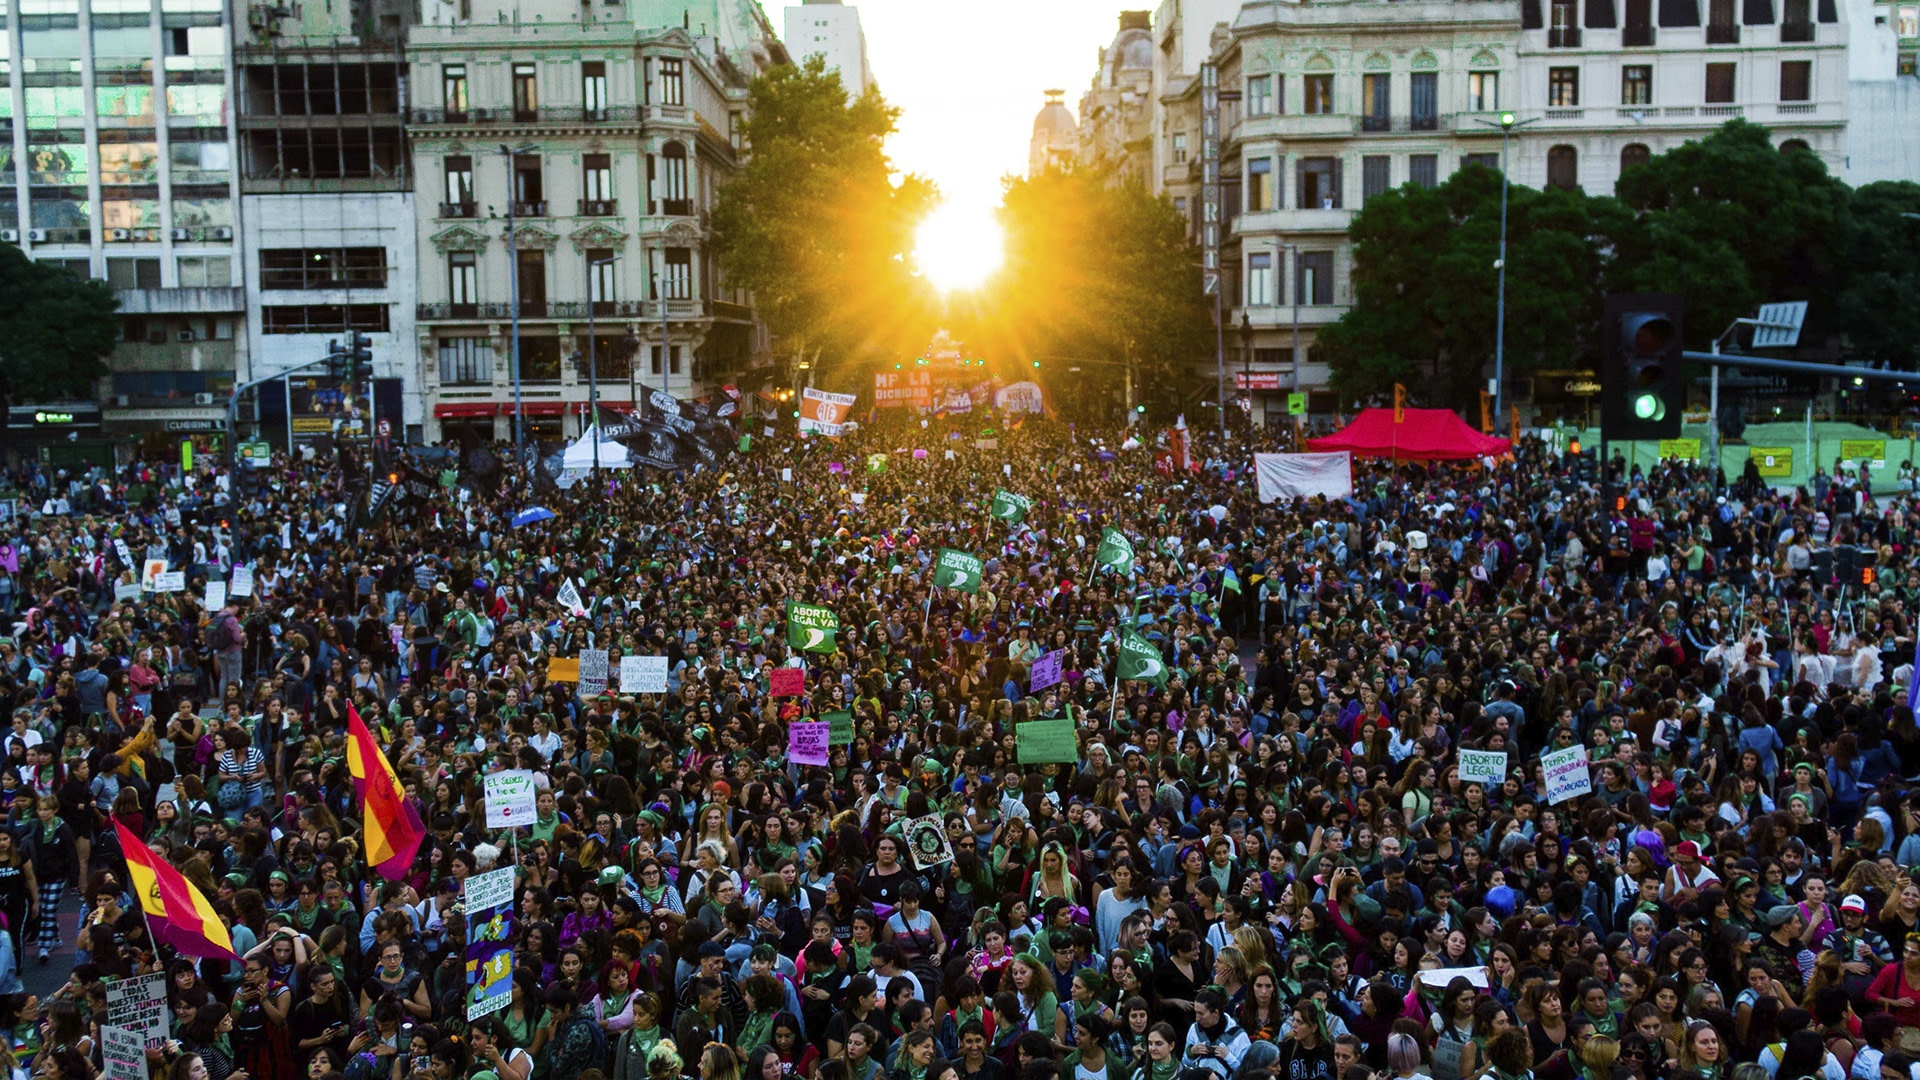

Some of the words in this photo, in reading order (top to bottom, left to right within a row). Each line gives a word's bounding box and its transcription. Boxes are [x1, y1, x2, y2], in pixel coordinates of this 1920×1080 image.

[1203, 202, 1218, 294] RITZ
[826, 392, 852, 403] INTERNA
[1007, 390, 1033, 400] NUEVA
[604, 425, 630, 436] LISTA
[945, 552, 978, 566] ABORTO
[941, 558, 964, 570] LEGAL
[967, 564, 980, 574] YA!
[791, 613, 818, 626] LEGAL
[1461, 754, 1504, 765] ABORTO
[1543, 756, 1566, 769] TIEMPO
[1568, 752, 1577, 761] DE
[1466, 766, 1497, 775] LEGAL
[486, 778, 498, 787] EL
[1547, 778, 1589, 799] PATRIARCADO
[466, 875, 480, 888] BART
[489, 869, 507, 880] QUIERO
[472, 891, 489, 902] ABORTO
[107, 981, 124, 992] HOY
[126, 979, 139, 987] NO
[140, 973, 165, 984] ESTAN
[122, 985, 148, 996] TODAS
[108, 992, 150, 1009] NUESTRAS
[109, 1006, 132, 1017] VOCES
[134, 996, 167, 1011] JUNTAS
[140, 1008, 161, 1018] DESDE
[149, 1018, 159, 1027] NO
